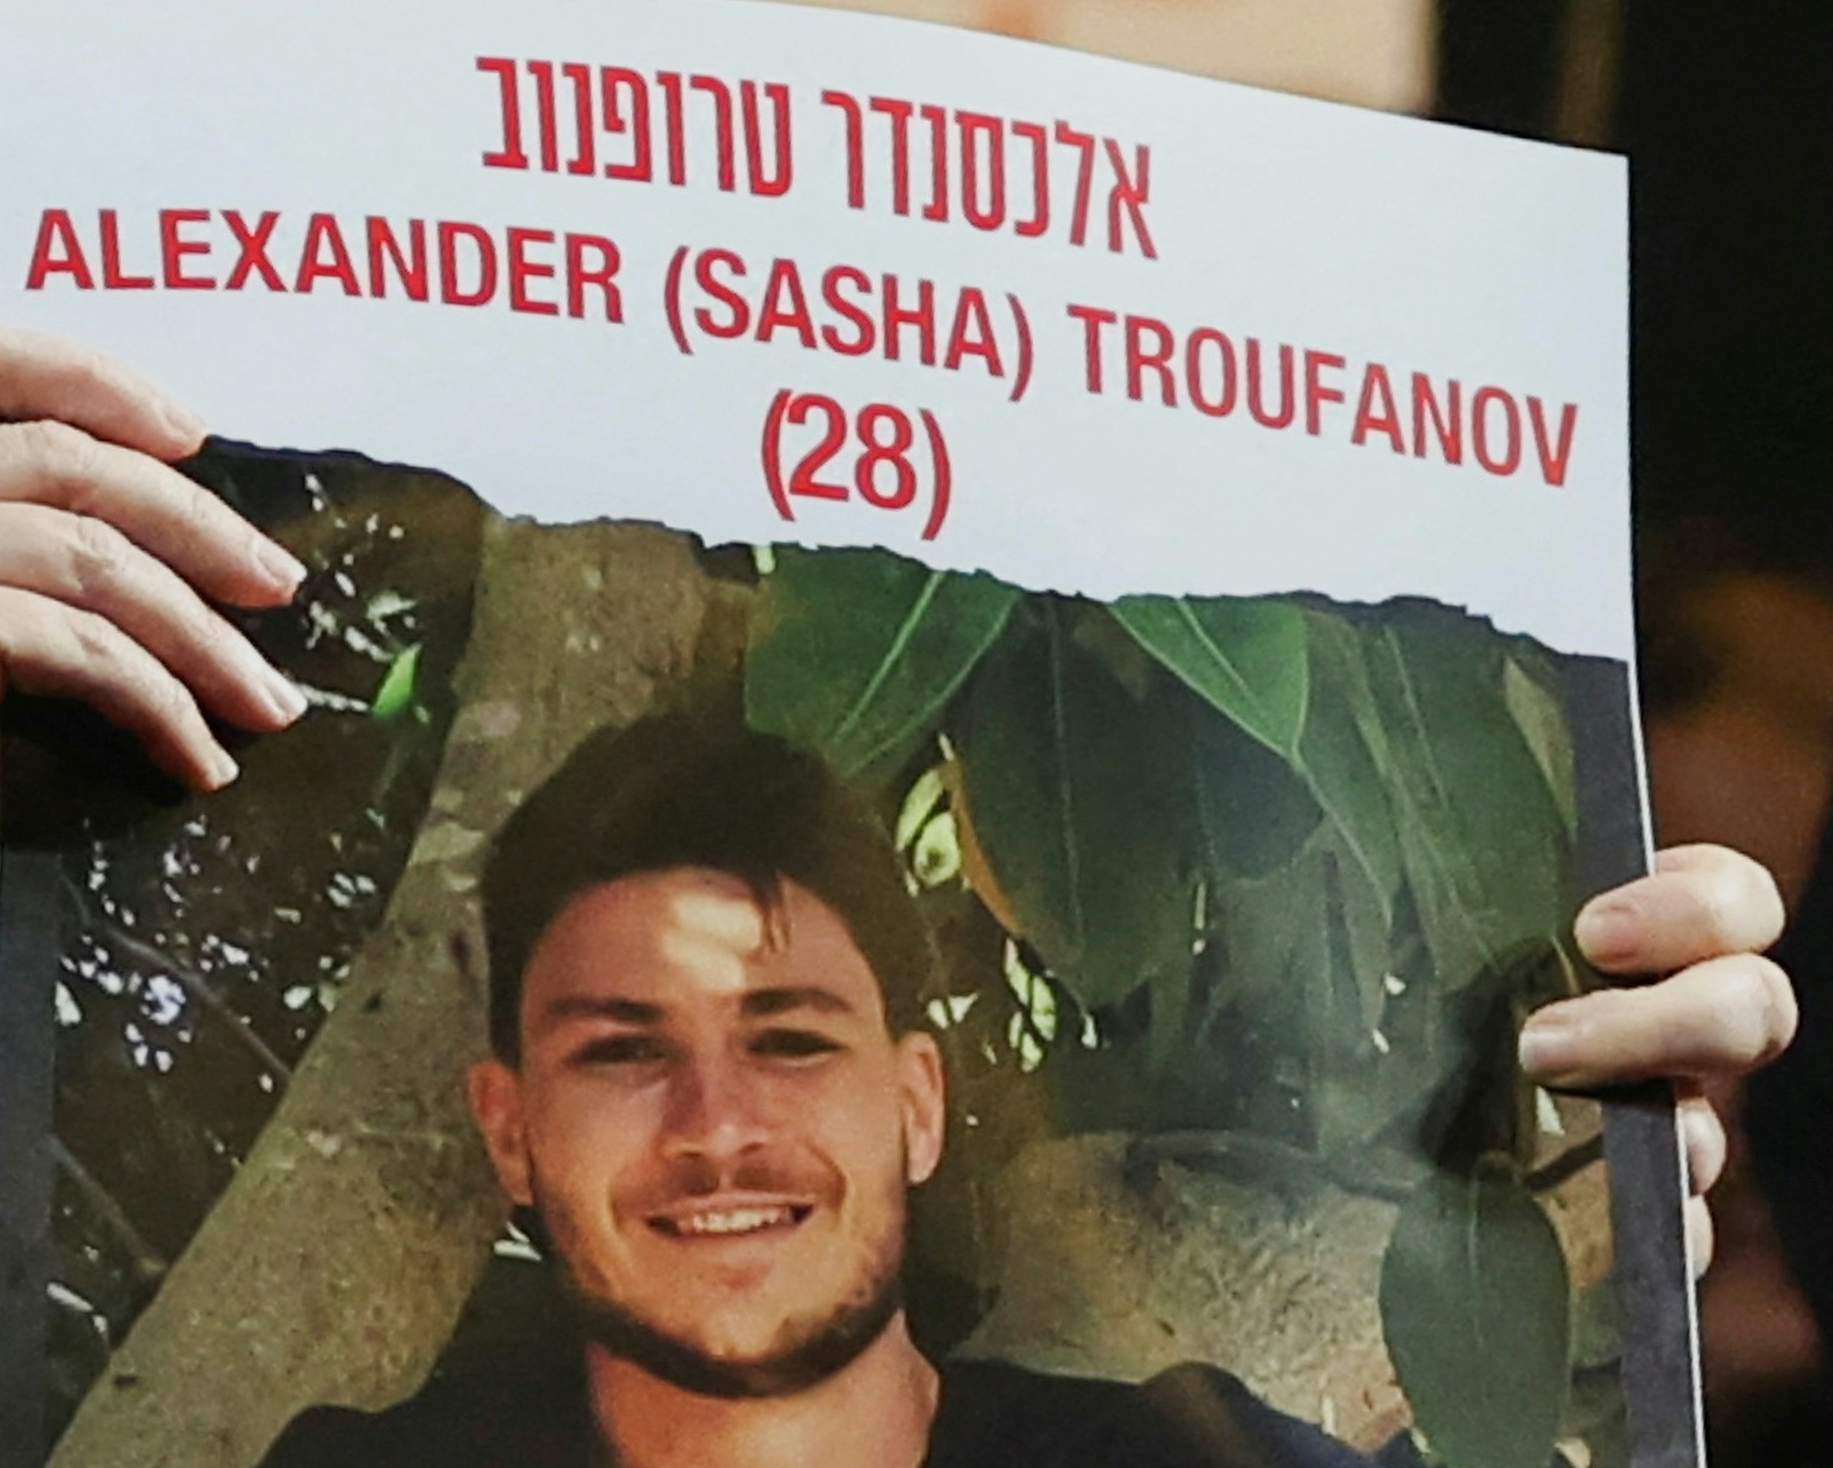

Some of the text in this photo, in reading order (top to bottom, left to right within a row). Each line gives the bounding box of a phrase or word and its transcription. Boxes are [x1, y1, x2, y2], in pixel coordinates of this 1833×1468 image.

[476, 56, 1158, 260] אלכסנדר טרופנוב
[24, 209, 1578, 488] ALEXANDER (SASHA) TROUFANOV
[762, 389, 952, 541] (28)
